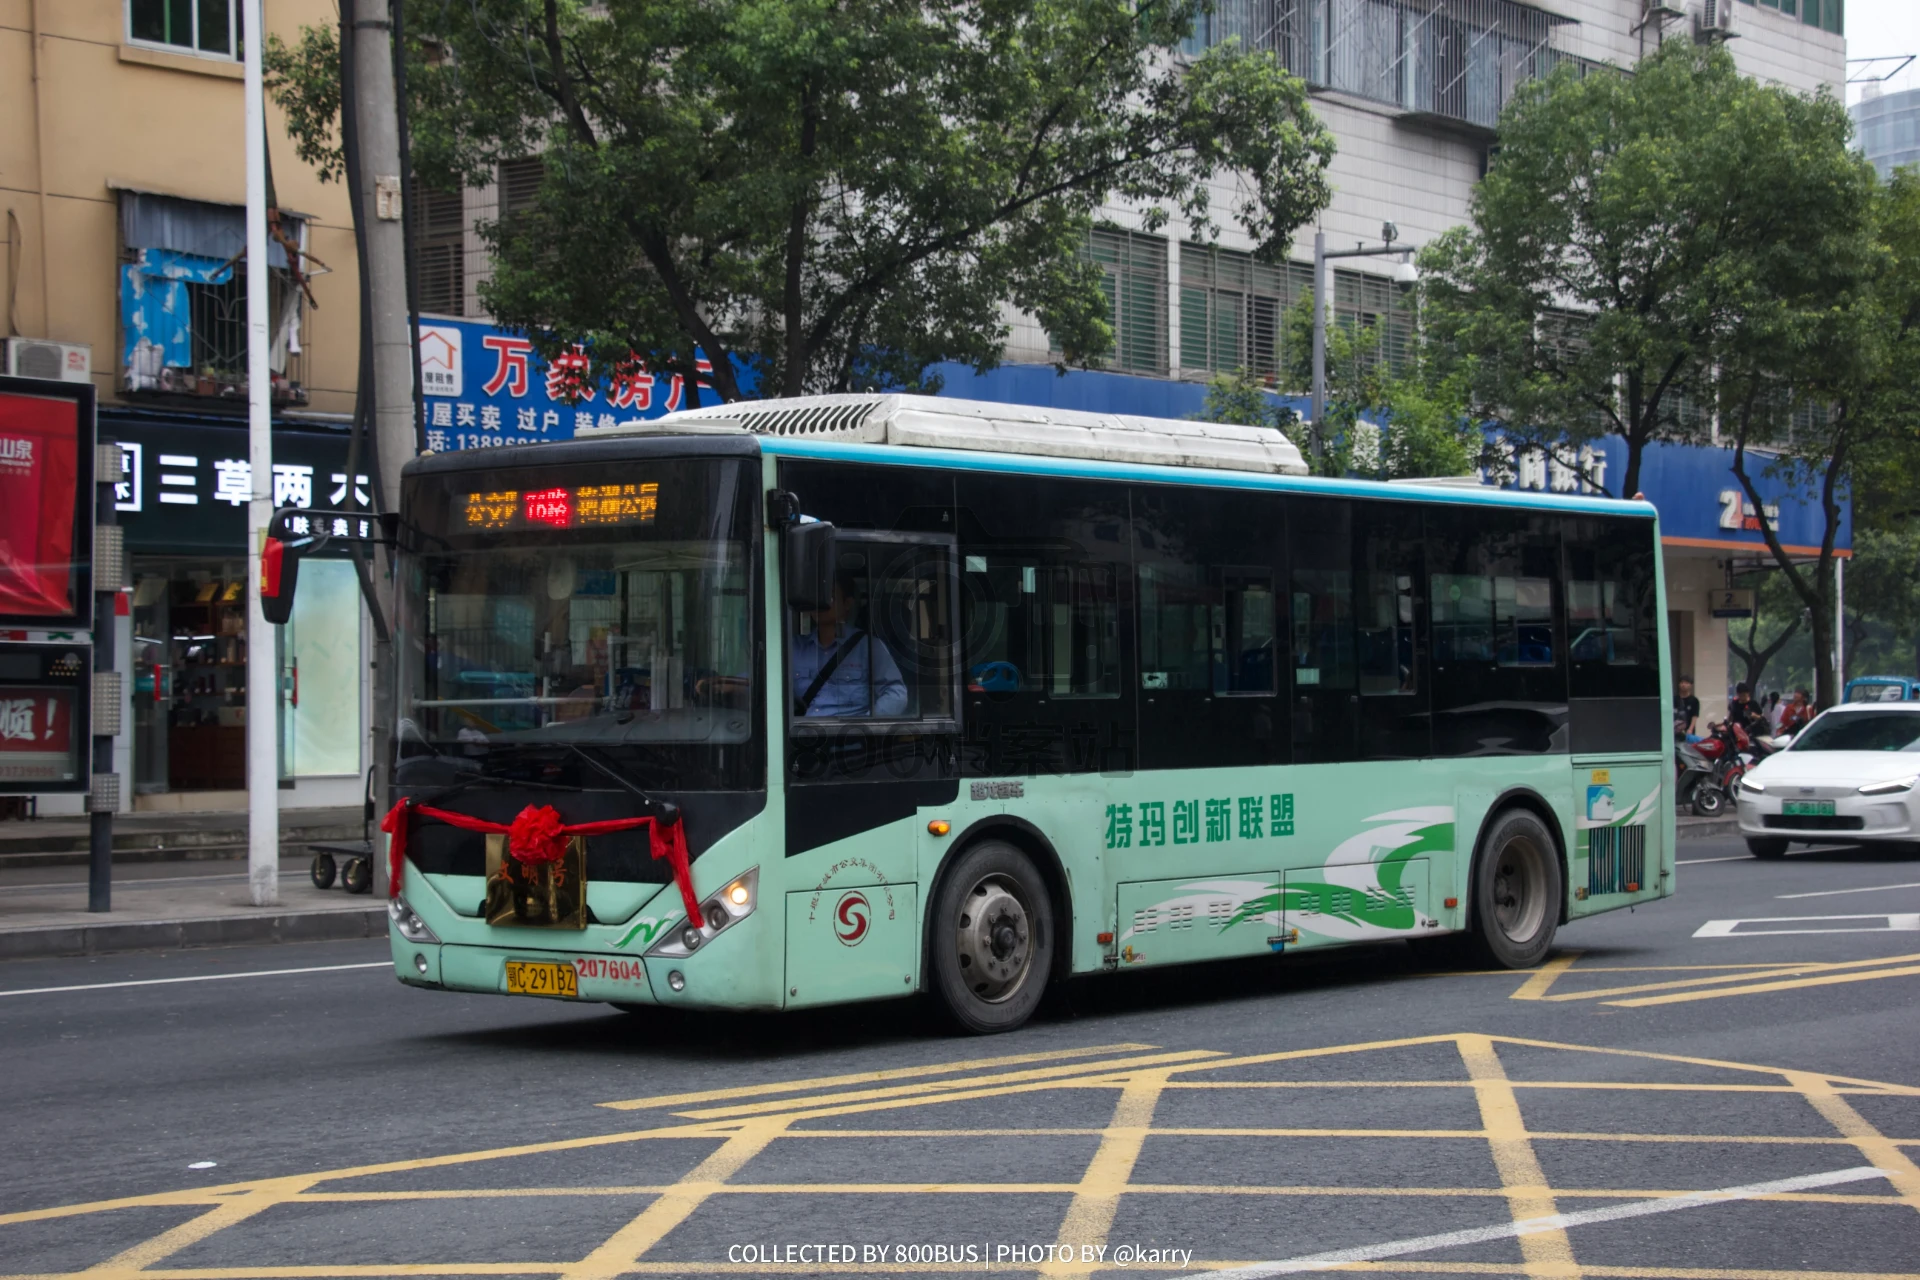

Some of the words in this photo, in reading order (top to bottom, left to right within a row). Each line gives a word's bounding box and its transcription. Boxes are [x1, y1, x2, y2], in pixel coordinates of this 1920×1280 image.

[517, 407, 560, 432] 过户
[1105, 793, 1295, 849] 特玛创新联盟
[577, 958, 642, 980] 207604
